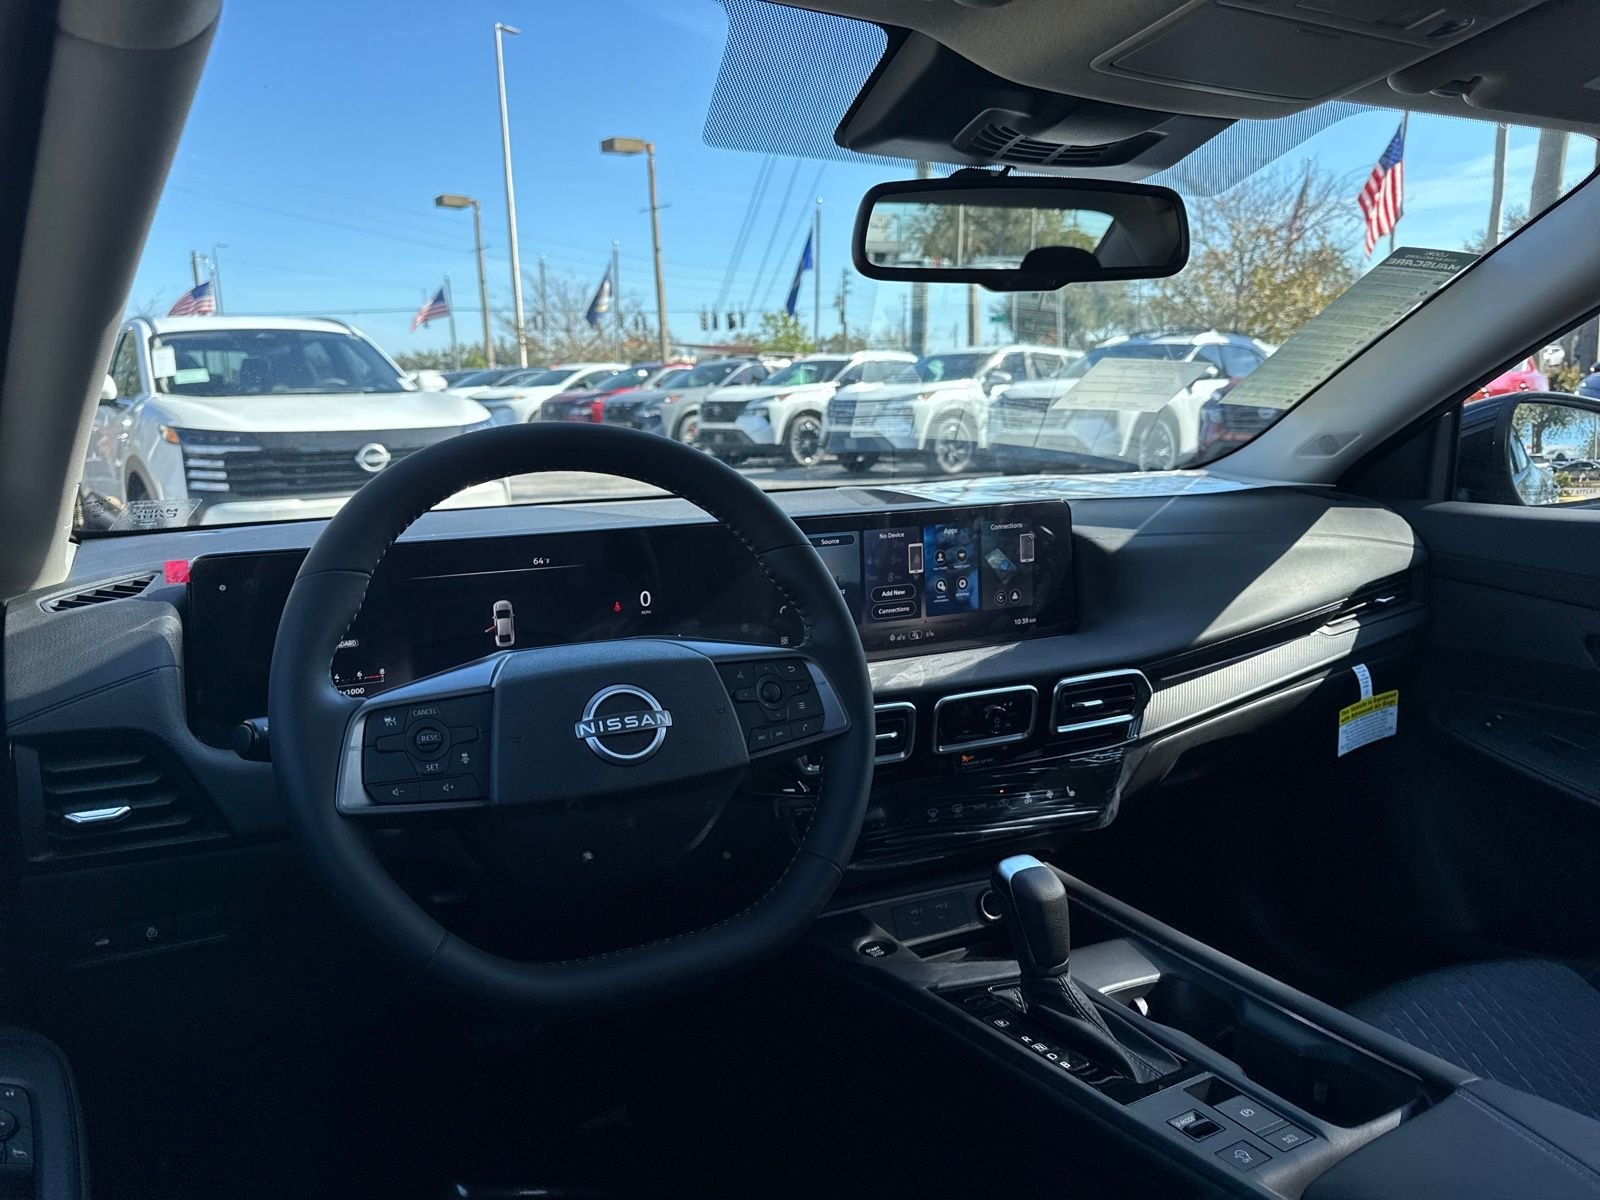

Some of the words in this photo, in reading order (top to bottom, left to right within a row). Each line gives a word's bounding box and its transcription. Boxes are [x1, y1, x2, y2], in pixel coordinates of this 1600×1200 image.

[990, 522, 1023, 531] Connections
[943, 528, 958, 536] Apps
[640, 590, 651, 607] 0
[878, 606, 910, 615] Connections
[413, 707, 437, 717] CANCEL
[578, 712, 670, 737] NISSAN
[425, 763, 440, 772] SET
[1020, 1035, 1033, 1044] R
[1046, 1052, 1058, 1061] D
[1059, 1061, 1071, 1070] B
